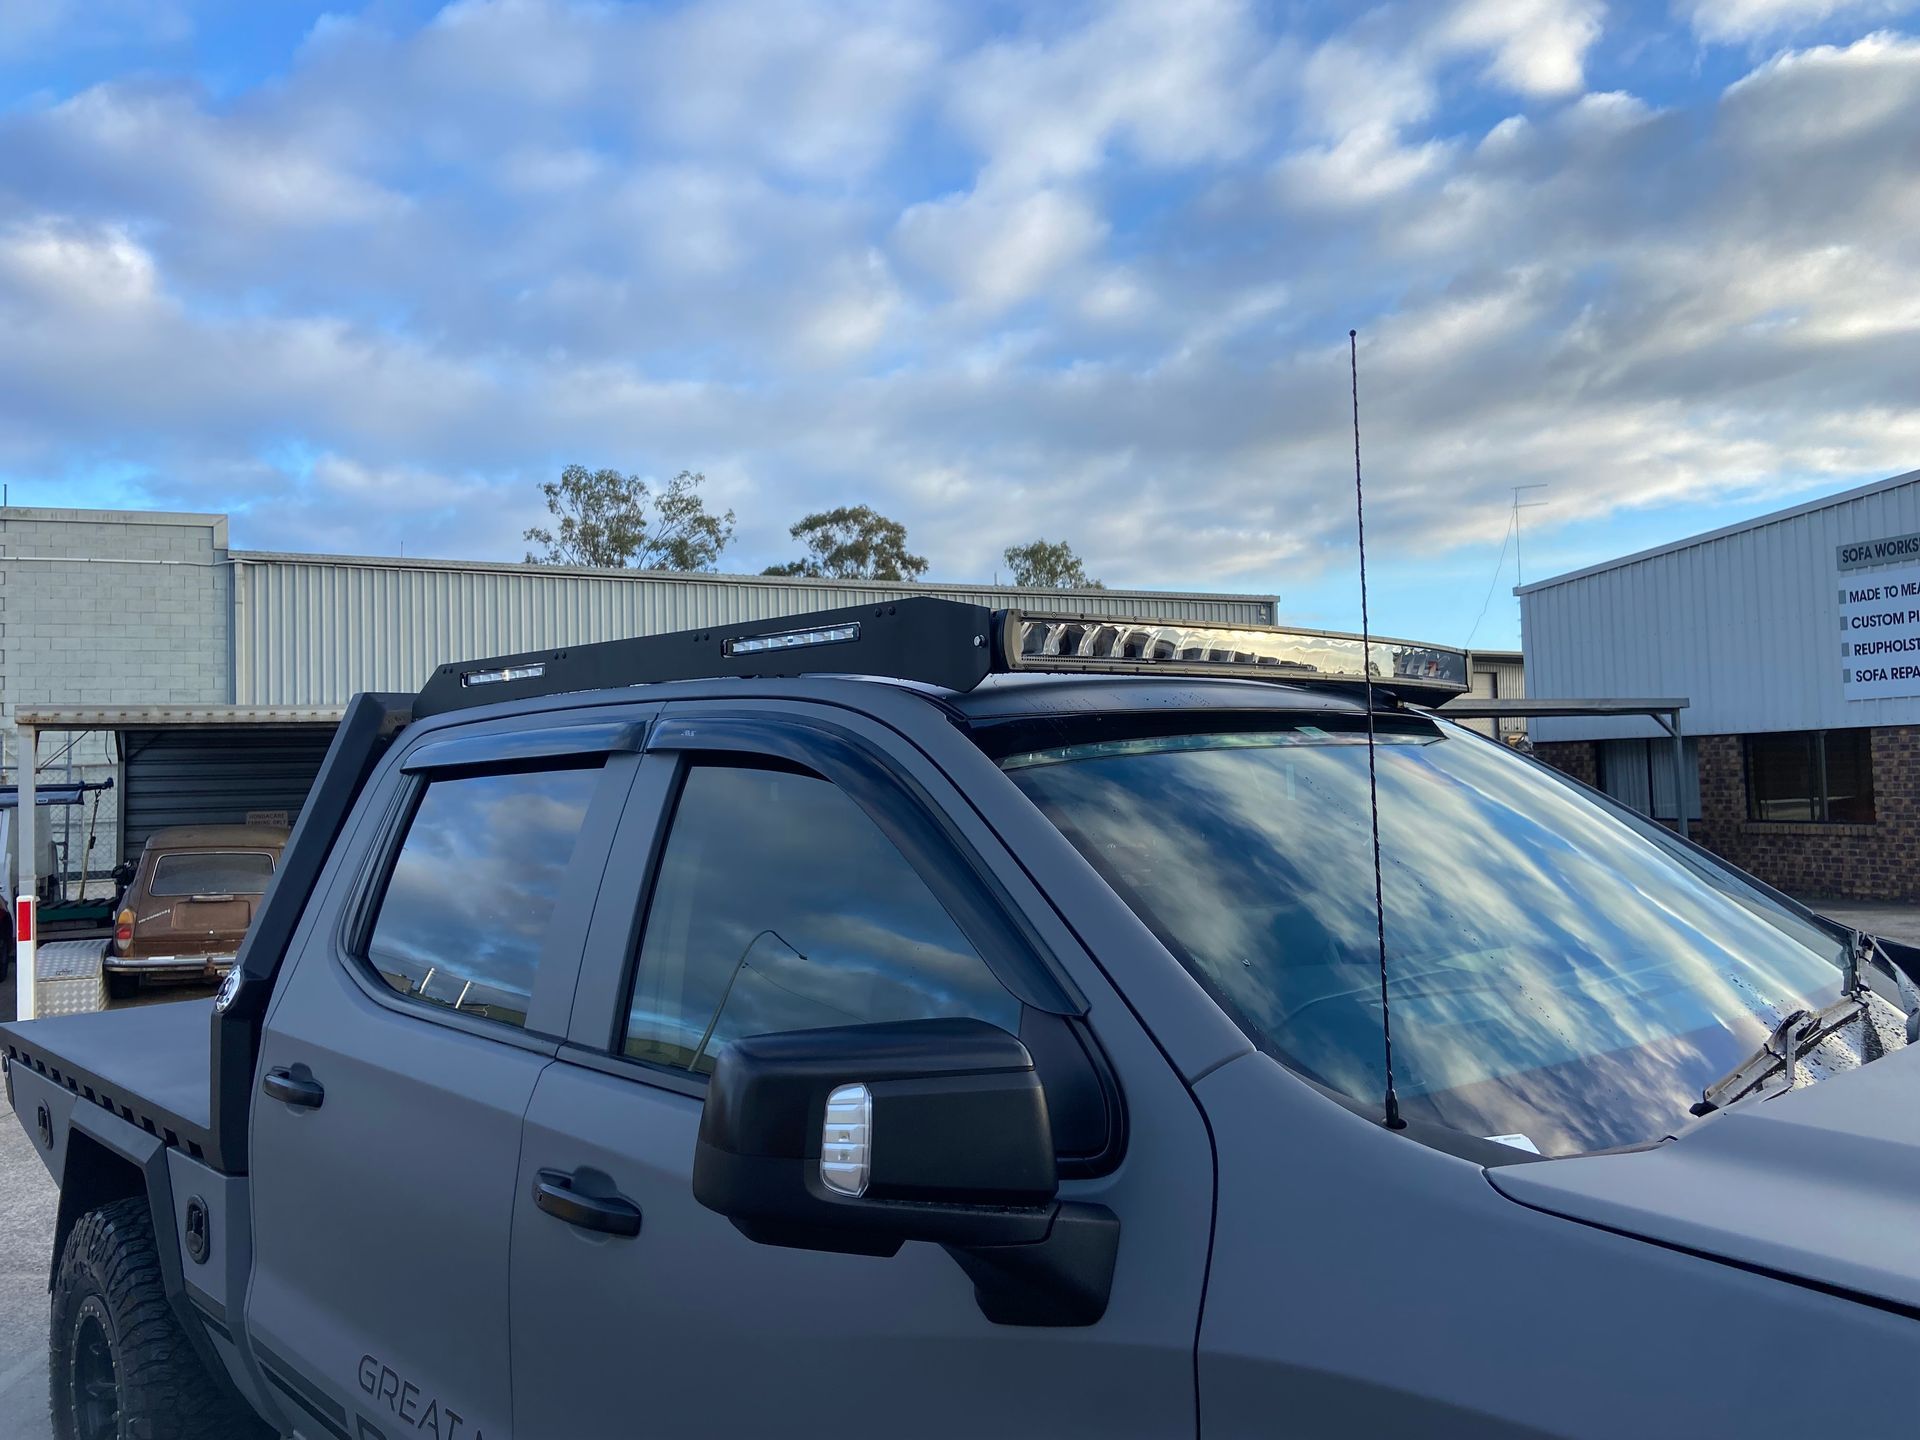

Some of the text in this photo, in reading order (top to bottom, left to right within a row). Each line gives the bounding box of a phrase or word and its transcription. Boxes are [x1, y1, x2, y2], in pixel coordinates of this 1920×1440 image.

[1842, 538, 1920, 563] SOFA WORKS
[1849, 588, 1881, 603] MADE
[1884, 585, 1899, 599] TO
[1851, 610, 1920, 629] CUSTOM PI
[1856, 665, 1920, 682] SOFA REPA
[358, 1354, 464, 1440] GREAT
